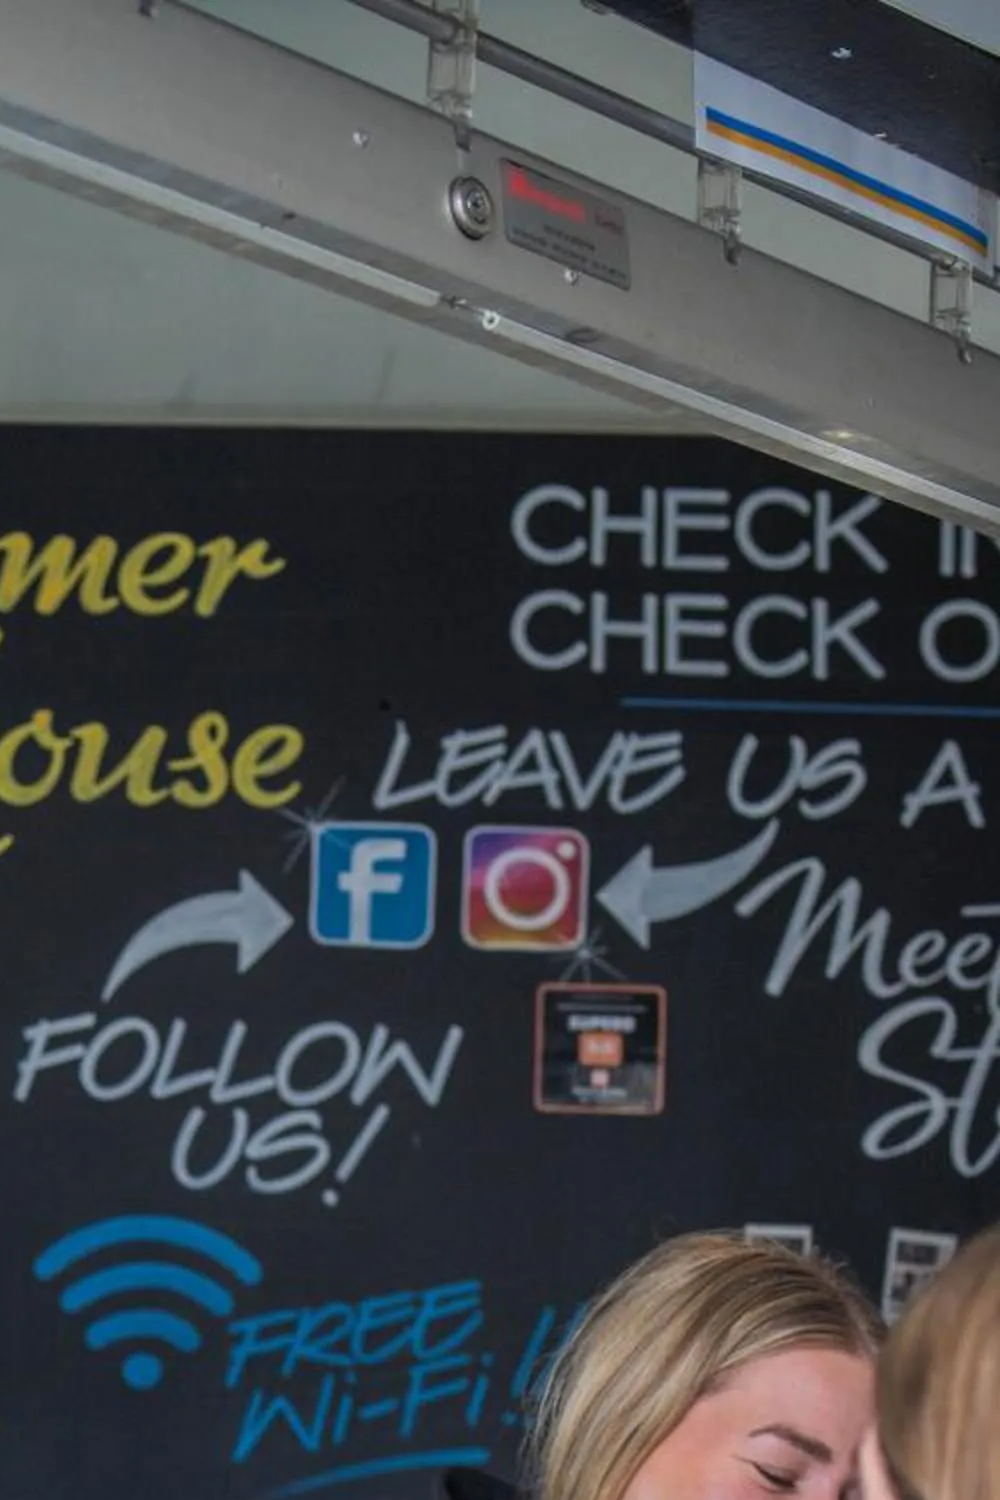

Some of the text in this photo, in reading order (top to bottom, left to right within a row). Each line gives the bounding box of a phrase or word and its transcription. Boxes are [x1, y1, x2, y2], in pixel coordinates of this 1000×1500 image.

[510, 484, 890, 574] CHECK
[509, 589, 887, 681] CHECK
[372, 719, 986, 830] LEAVE US A
[13, 1012, 465, 1107] FOLLOW
[170, 1103, 391, 1208] US!
[224, 1279, 486, 1391] FREE
